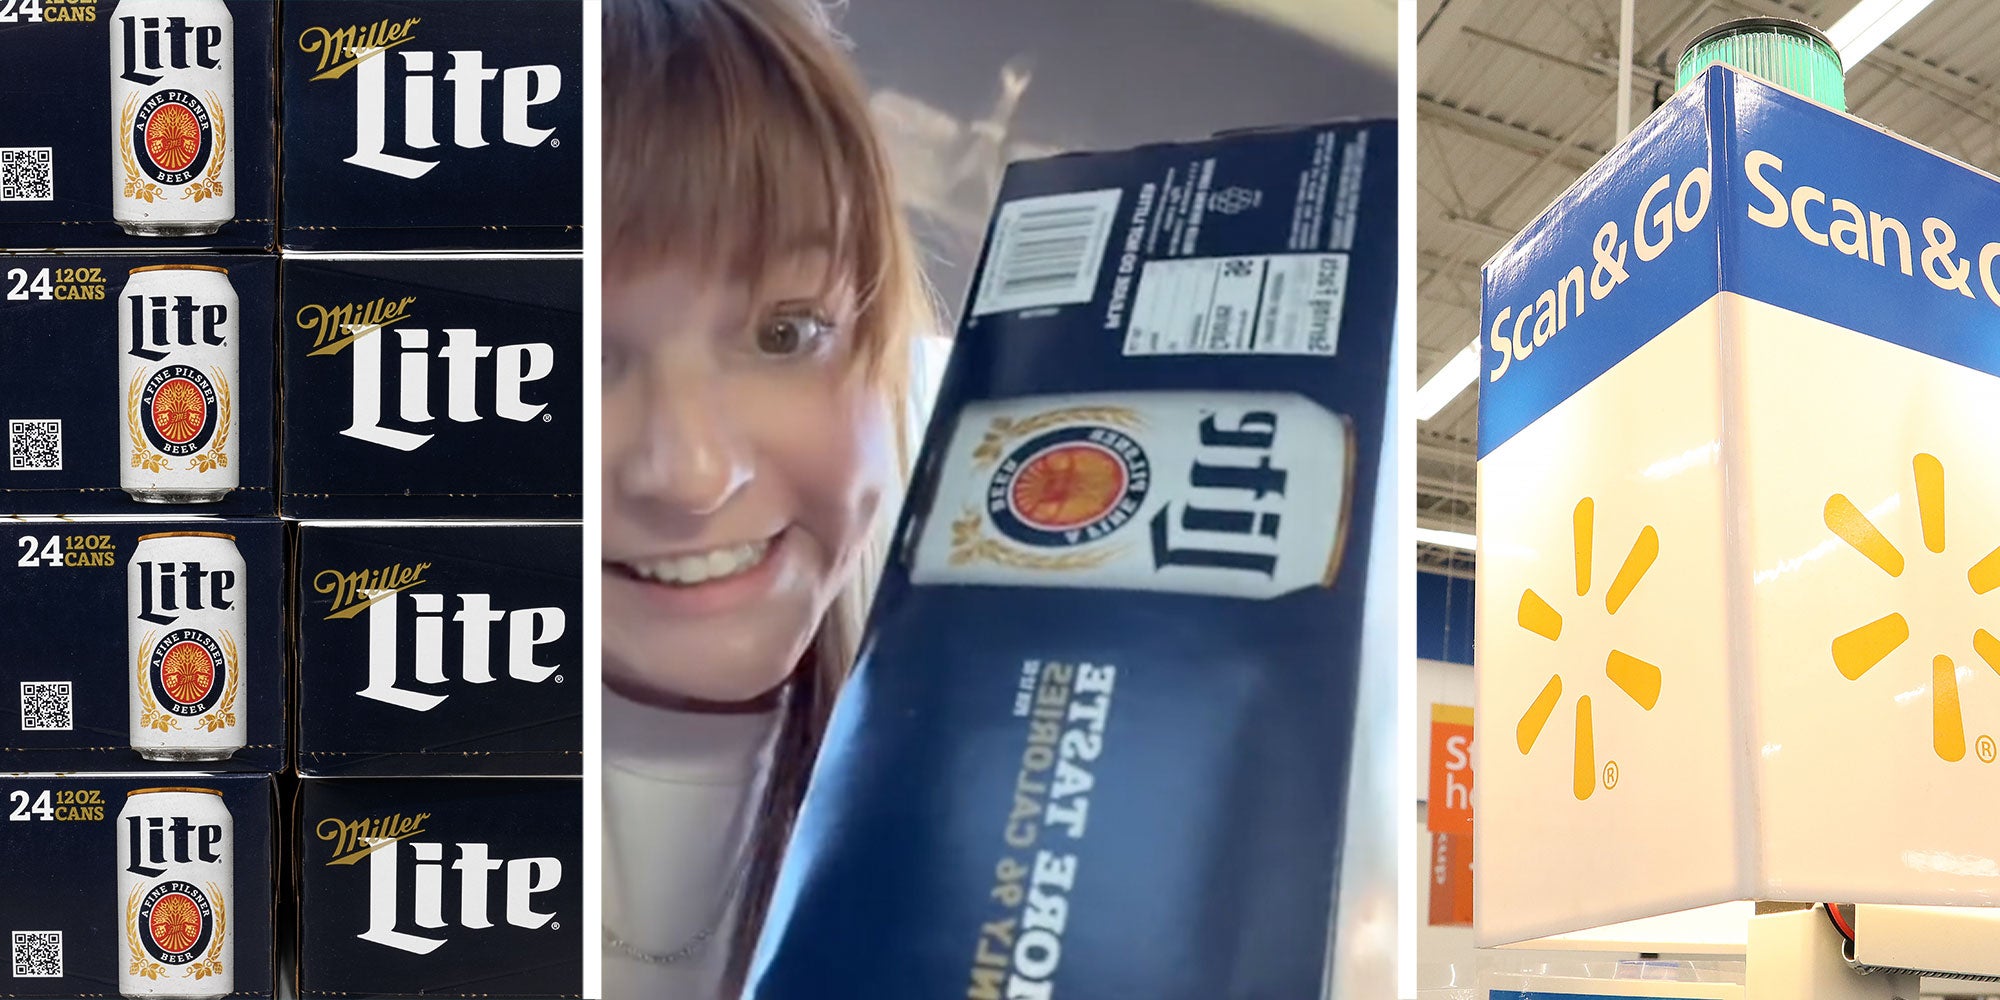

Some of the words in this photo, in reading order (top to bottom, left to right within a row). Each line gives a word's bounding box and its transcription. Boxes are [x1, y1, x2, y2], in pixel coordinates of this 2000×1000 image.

[0, 0, 43, 23] 24
[44, 6, 97, 23] CANS
[119, 16, 222, 86] Lite
[299, 18, 421, 73] Miller
[140, 94, 166, 120] FINE
[168, 91, 210, 131] PILSNER
[343, 46, 562, 180] Lite
[136, 123, 145, 131] A
[156, 171, 193, 183] BEER
[7, 268, 53, 301] 24
[56, 268, 107, 283] 12OZ.
[54, 285, 106, 301] CANS
[128, 294, 228, 362] Lite
[297, 297, 417, 349] Miller
[143, 397, 151, 405] A
[147, 369, 171, 395] FINE
[175, 367, 215, 405] PILSNER
[340, 323, 554, 452] Lite
[163, 442, 198, 454] BEER
[18, 535, 63, 568] 24
[65, 535, 116, 550] 12OZ.
[64, 552, 115, 567] CANS
[137, 561, 235, 626] Lite
[314, 563, 431, 613] Miller
[156, 633, 180, 657] FINE
[184, 630, 223, 666] PILSNER
[356, 588, 566, 712] Lite
[172, 703, 206, 714] BEER
[10, 789, 54, 822] 24
[54, 806, 105, 822] CANS
[56, 790, 105, 805] 12OZ.
[126, 815, 222, 878] Lite
[317, 813, 431, 858] Miller
[144, 885, 168, 911] FINE
[172, 883, 210, 917] PILSNER
[357, 837, 562, 955] Lite
[141, 910, 149, 918] A
[160, 952, 194, 963] BEER
